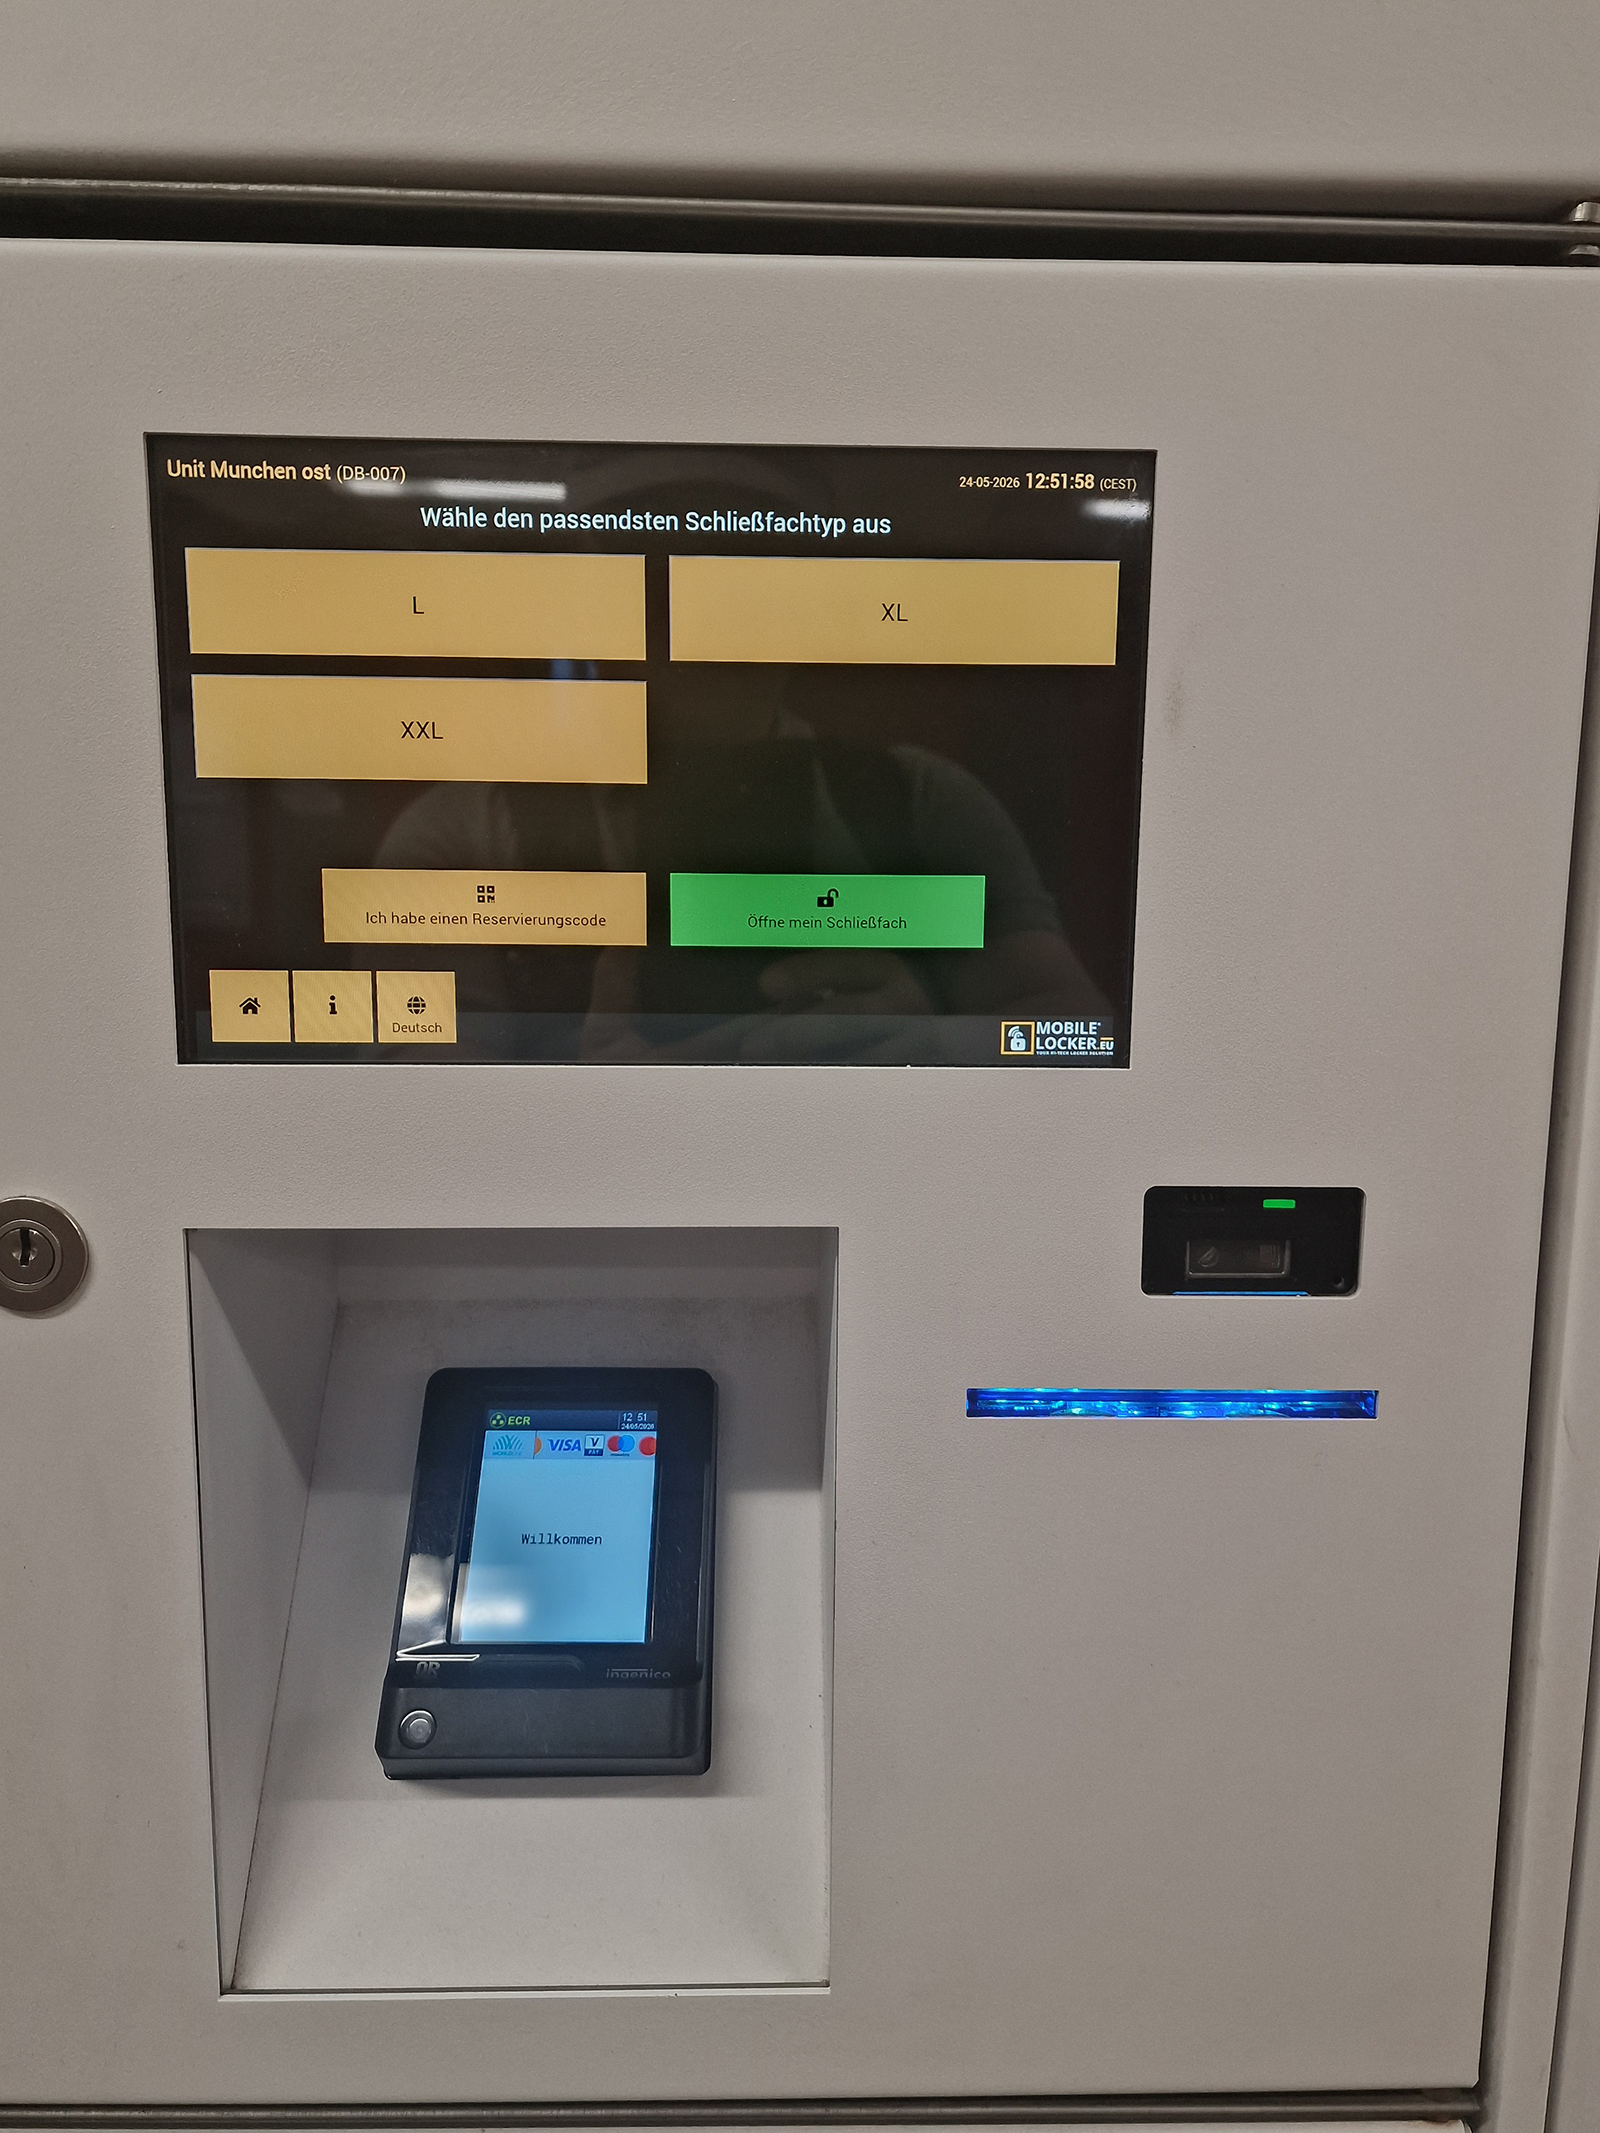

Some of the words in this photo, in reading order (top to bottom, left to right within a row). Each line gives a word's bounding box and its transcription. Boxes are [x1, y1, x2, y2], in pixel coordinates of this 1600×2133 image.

[167, 459, 205, 478] Unit
[210, 460, 297, 480] Munchen
[301, 464, 331, 480] ost
[336, 465, 406, 484] (DB-007)
[959, 476, 1020, 489] 24-05-2026
[1026, 472, 1095, 490] 12:51:58
[1100, 478, 1137, 492] (CEST)
[420, 505, 489, 529] Wähle
[493, 509, 534, 529] den
[540, 510, 679, 534] passendsten
[685, 511, 847, 538] Schließfachtyp
[852, 517, 892, 534] aus
[412, 596, 424, 614] L
[881, 603, 908, 622] XL
[401, 721, 443, 740] XXL
[366, 912, 388, 925] Ich
[391, 912, 426, 925] habe
[430, 912, 468, 925] einen
[472, 913, 607, 929] Reservierungscode
[748, 914, 785, 928] Öffne
[789, 916, 822, 929] mein
[827, 916, 907, 929] Schließfach
[392, 1022, 442, 1033] Deutsch
[1036, 1037, 1114, 1050] LOCKER.EU
[507, 1416, 531, 1426] ECR
[548, 1438, 582, 1452] VISA
[590, 1437, 600, 1447] V
[521, 1533, 602, 1545] Willkommen
[606, 1669, 671, 1679] ingenico
